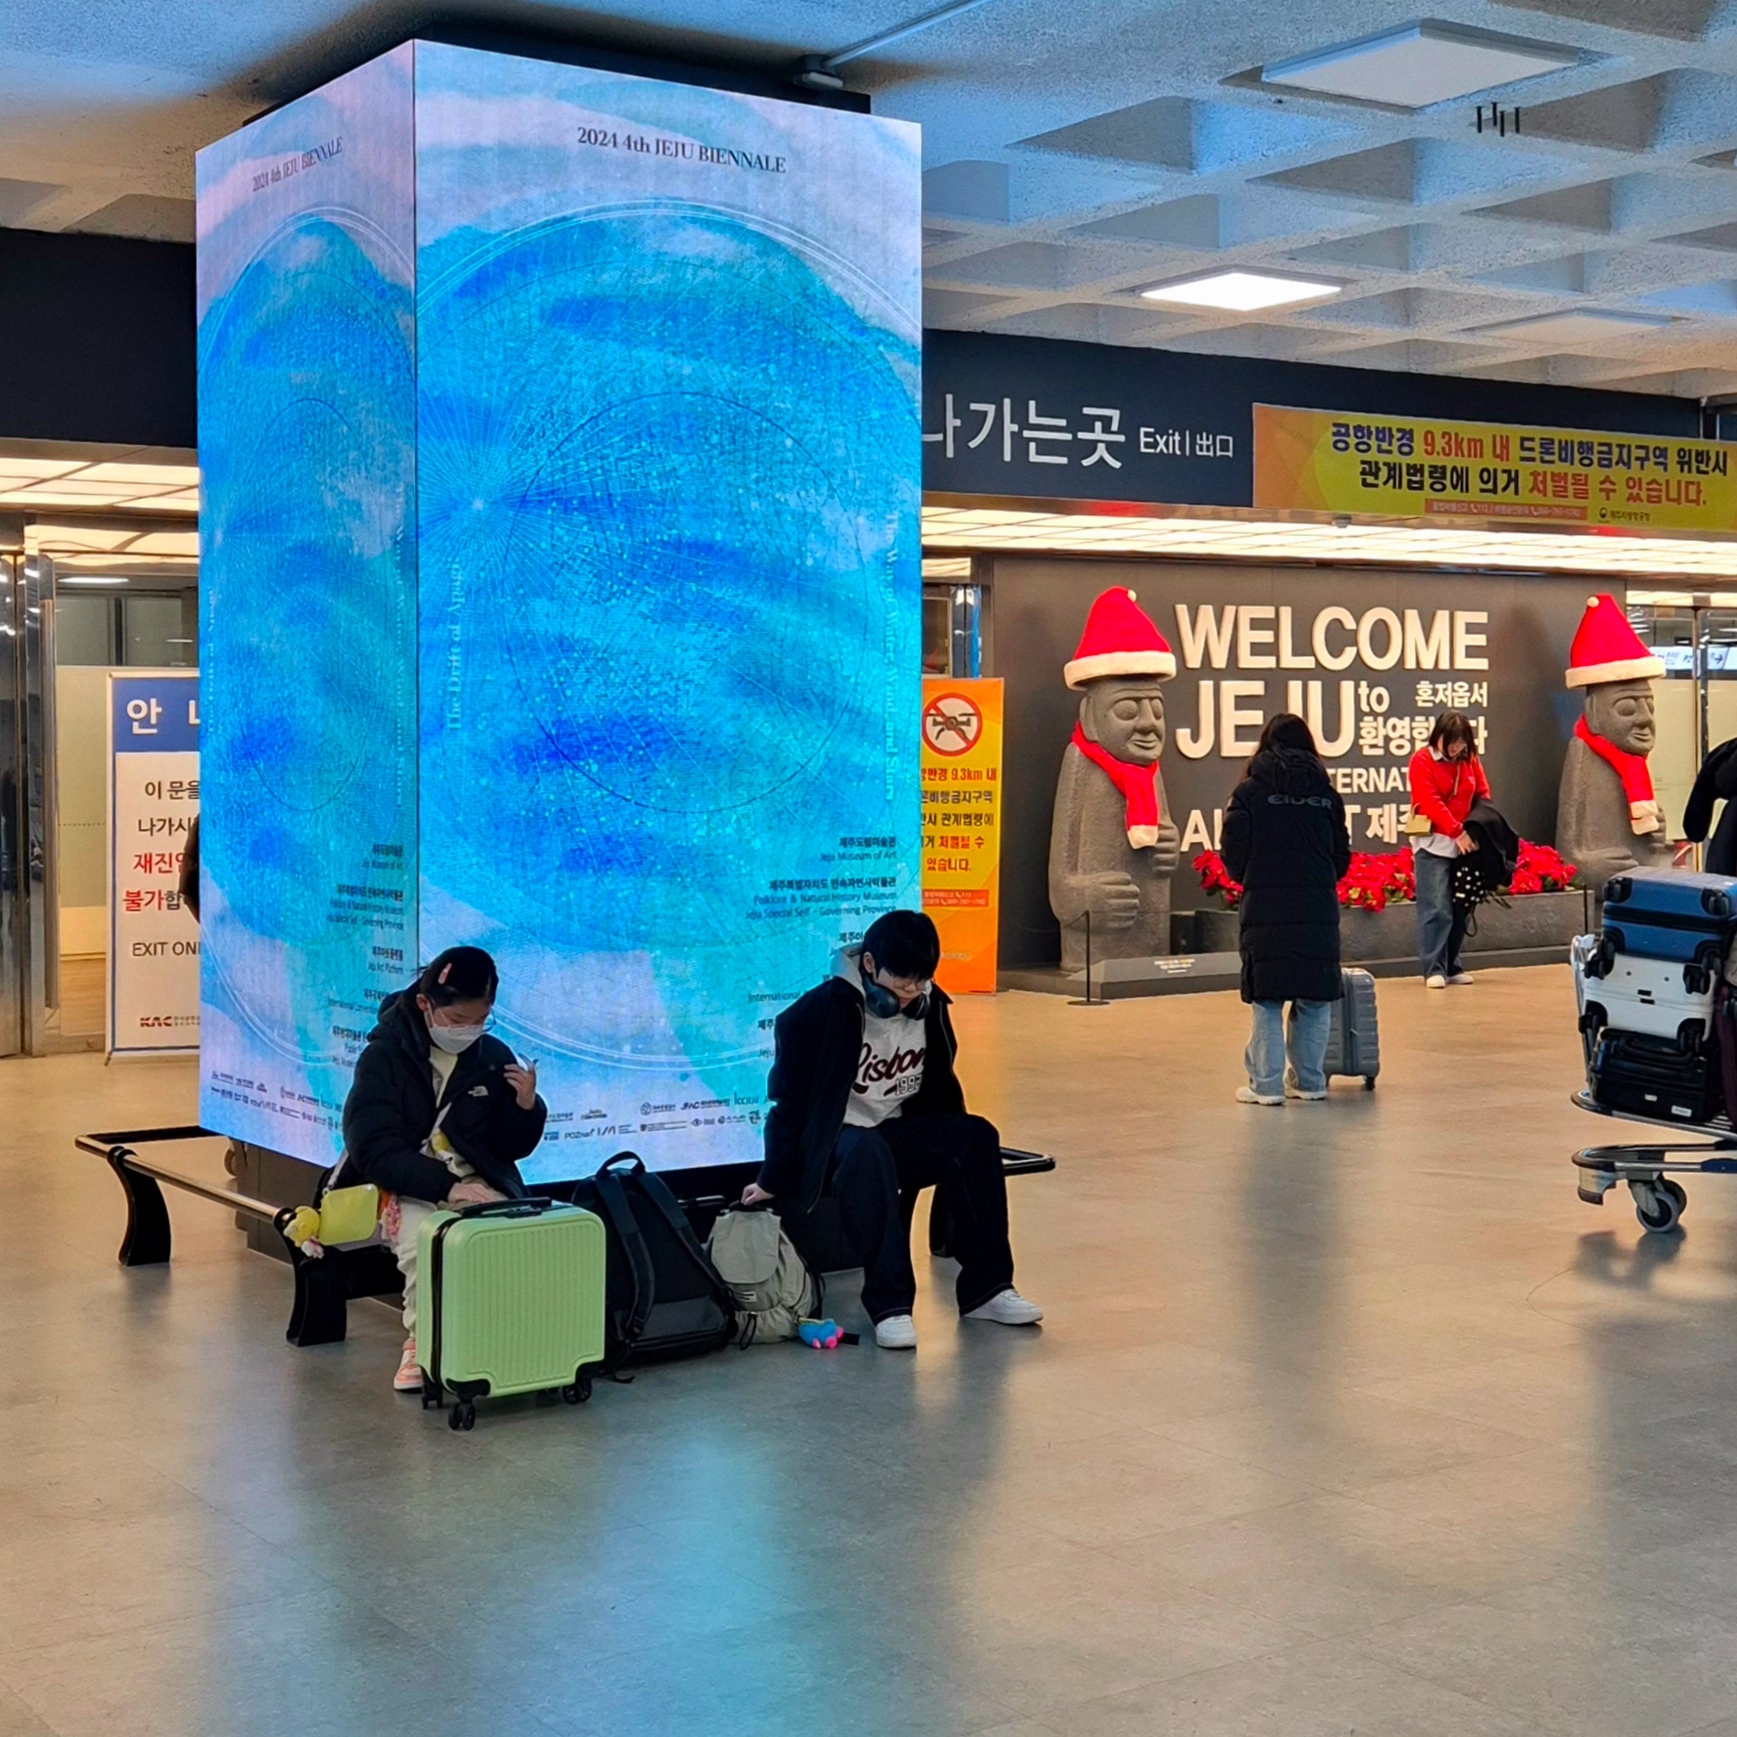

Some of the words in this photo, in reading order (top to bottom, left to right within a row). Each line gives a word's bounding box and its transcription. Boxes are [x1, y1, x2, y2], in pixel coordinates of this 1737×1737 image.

[577, 126, 618, 149] 2024
[622, 134, 651, 154] 4th
[653, 138, 695, 160] JEJU
[699, 144, 787, 174] BIENNALE
[1139, 426, 1182, 456] Exit
[1195, 431, 1234, 458] 出口
[1331, 422, 1415, 457] 공항반경
[1423, 429, 1484, 459] 9.3km
[1492, 434, 1510, 463] 내
[1519, 436, 1669, 473] 드론비행금지구역
[1676, 447, 1728, 477] 위반시
[1359, 459, 1470, 494] 관계법령에
[1479, 466, 1520, 496] 의거
[1529, 469, 1590, 500] 처벌될
[1598, 475, 1618, 502] 수
[1625, 476, 1707, 507] 있습니다.
[1175, 604, 1489, 671] WELCOME
[1358, 681, 1390, 713] to
[1415, 680, 1488, 708] 혼저옵서
[1358, 716, 1488, 756] 환영합다
[921, 767, 948, 781] 항반경
[951, 768, 983, 781] 9.3km
[986, 767, 997, 781] 내
[144, 780, 162, 800] 이
[921, 790, 993, 804] 론비행금지구역
[138, 816, 193, 837] 나가시
[122, 889, 184, 912] 불가합
[132, 942, 168, 957] EXIT
